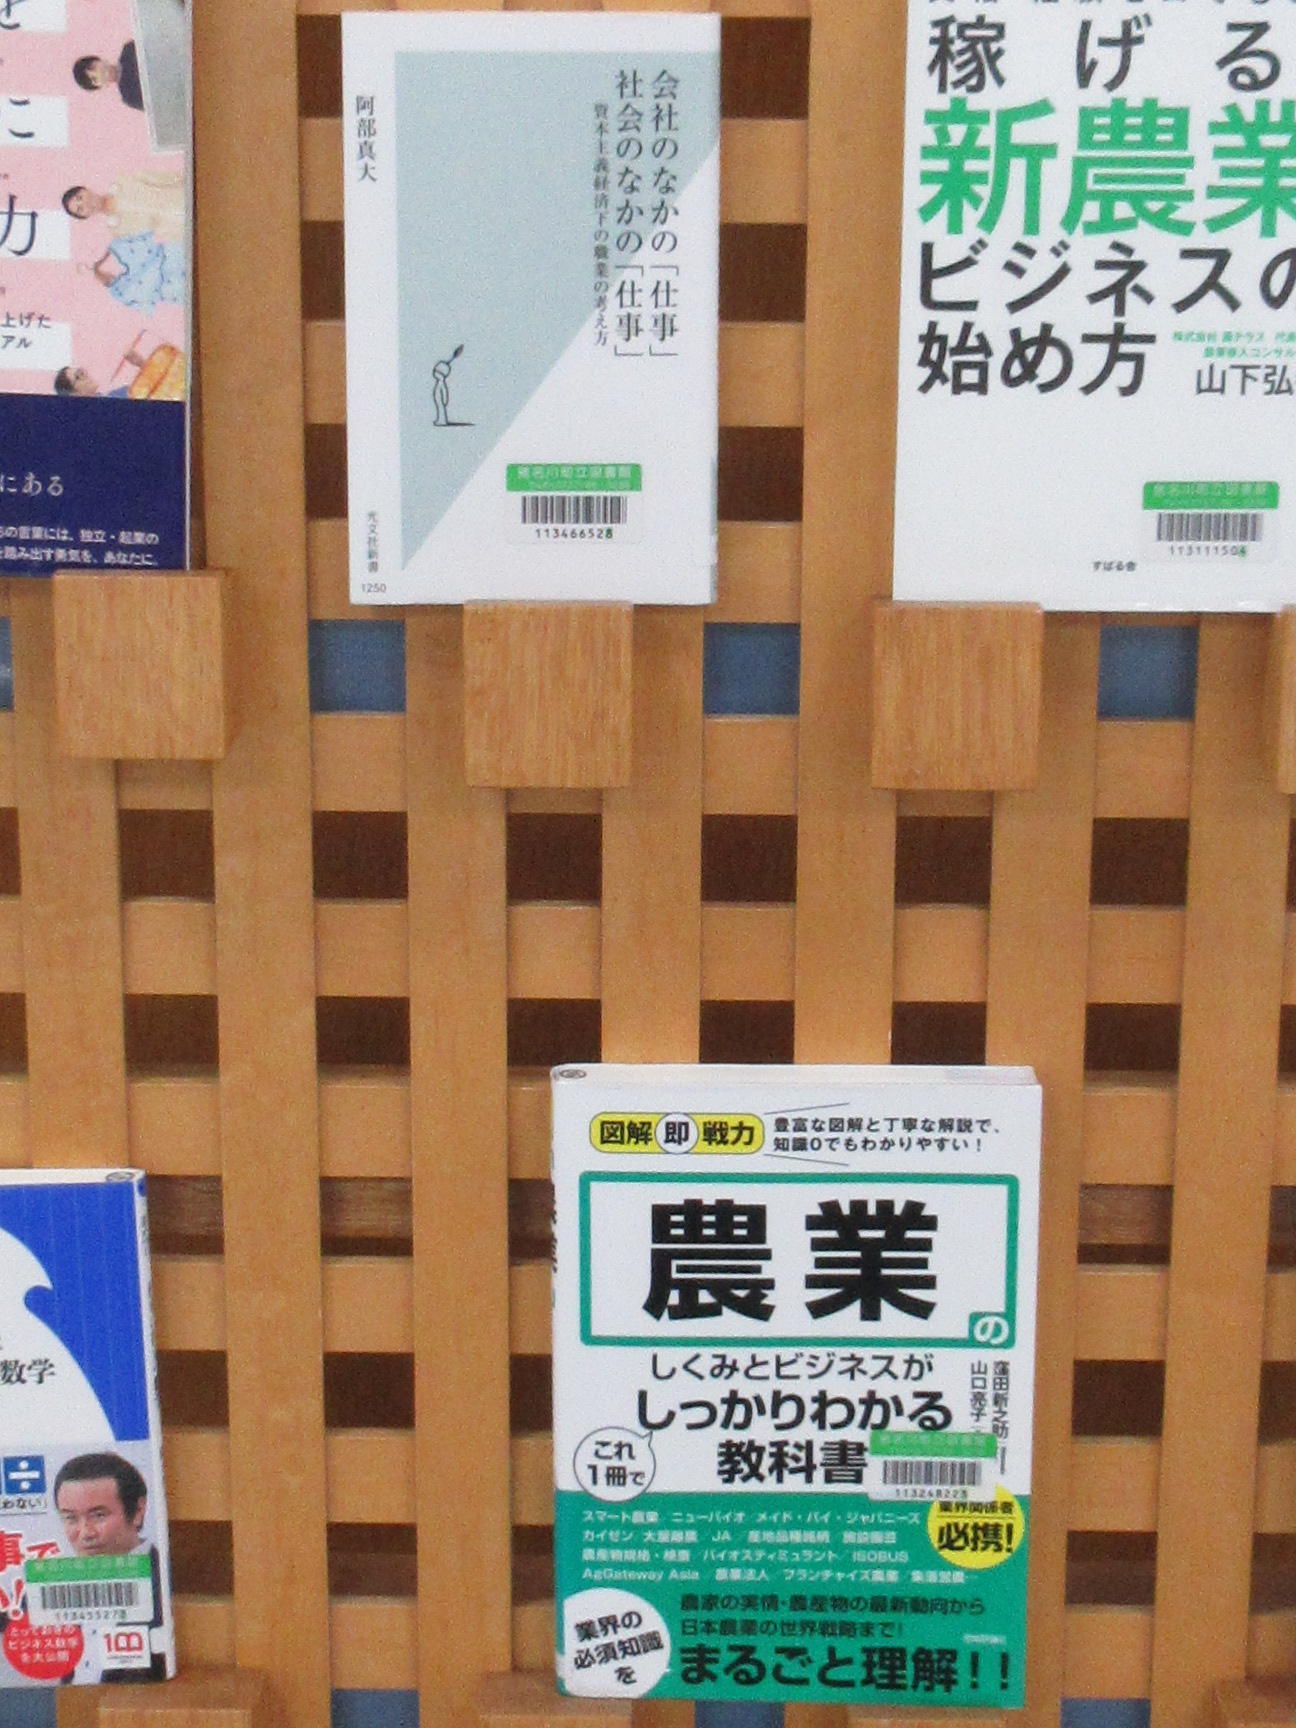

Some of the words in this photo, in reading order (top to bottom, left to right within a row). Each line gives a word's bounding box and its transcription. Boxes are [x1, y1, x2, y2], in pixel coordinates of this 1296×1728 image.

[355, 95, 378, 183] 阿部真大
[614, 69, 645, 359] 社会のなかの「仕事」
[650, 69, 680, 359] 会社のなかの「仕事」
[917, 320, 1157, 397] 始め方
[535, 528, 614, 540] 113466528
[361, 582, 387, 593] 1250
[773, 1116, 1001, 1136] 豊富な図解と丁寧な解説で、
[641, 1198, 939, 1322] 農業
[972, 1314, 1010, 1345] の
[650, 1353, 935, 1382] しくみとビジネスが
[636, 1388, 953, 1433] しっかりわかる
[593, 1440, 636, 1462] これ
[716, 1437, 870, 1485] 教科書
[574, 1610, 643, 1646] 業界の
[572, 1633, 664, 1670] 必須知識
[615, 1665, 637, 1684] を
